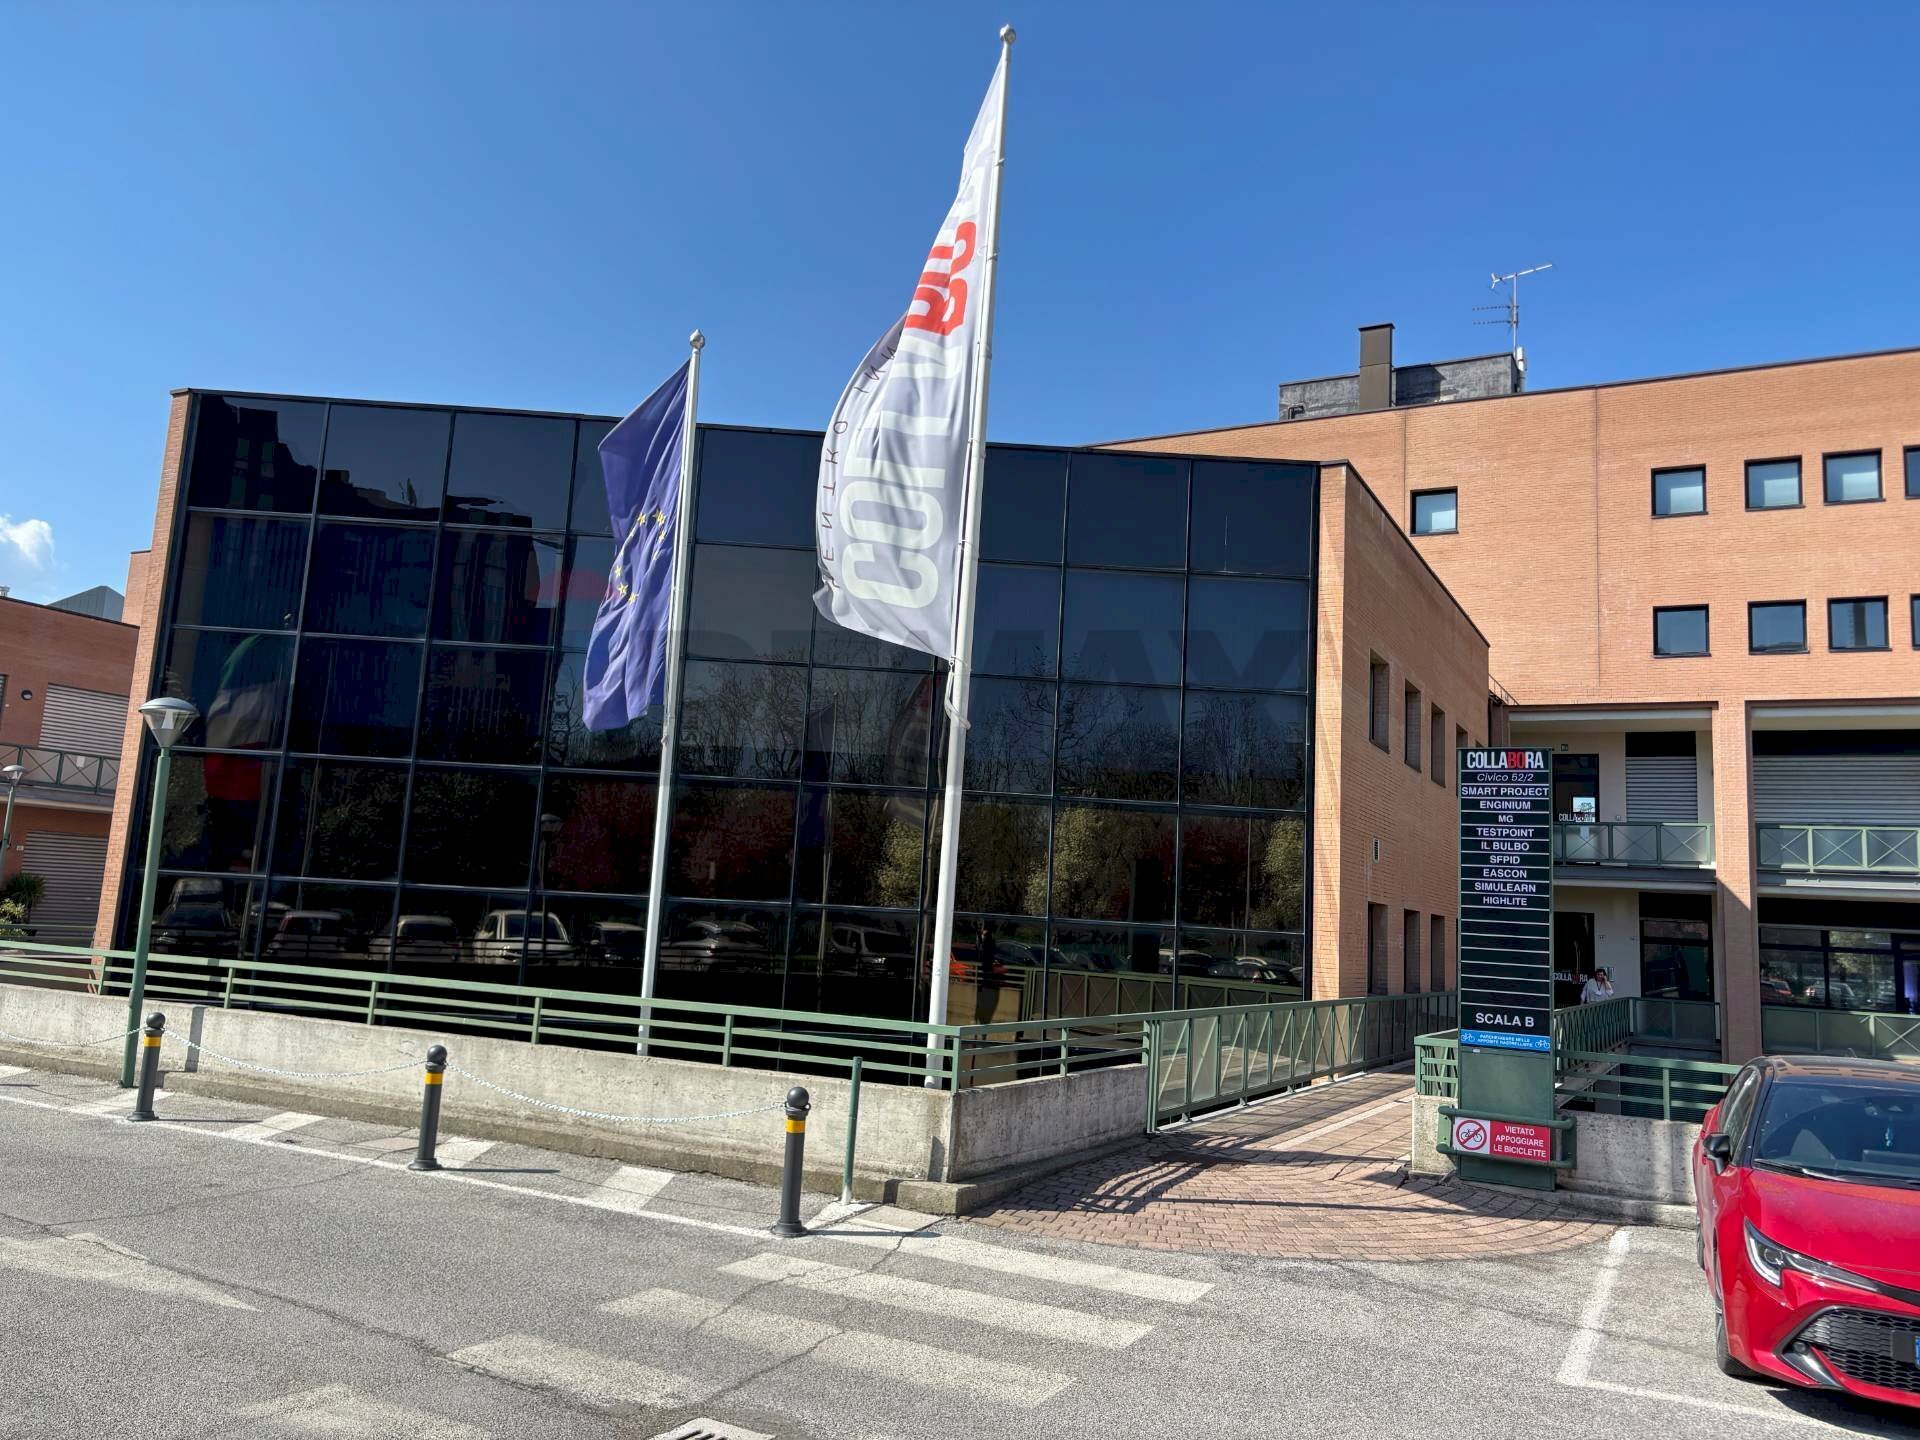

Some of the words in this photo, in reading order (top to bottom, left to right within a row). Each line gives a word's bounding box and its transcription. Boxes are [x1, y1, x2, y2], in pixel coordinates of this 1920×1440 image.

[1467, 751, 1544, 769] COLLABORA
[1477, 773, 1508, 782] Civico
[1511, 773, 1534, 782] 52/2
[1461, 786, 1498, 796] SMART
[1500, 787, 1549, 796] PROJECT
[1479, 800, 1531, 810] ENGINIUM
[1498, 815, 1514, 823] MG
[1476, 827, 1534, 838] TESTPOINT
[1481, 841, 1490, 850] IL
[1492, 841, 1530, 851] BULBO
[1489, 855, 1521, 865] SFPID
[1483, 868, 1527, 879] EASCON
[1474, 882, 1537, 893] SIMULEARN
[1483, 896, 1528, 906] HIGHLITE
[1475, 1012, 1521, 1027] SCALA
[1525, 1016, 1535, 1027] B
[1504, 1125, 1535, 1136] VIETATO
[1495, 1134, 1544, 1148] APPOGGIARE
[1493, 1144, 1502, 1152] LE
[1504, 1145, 1547, 1158] BICICLETTE
